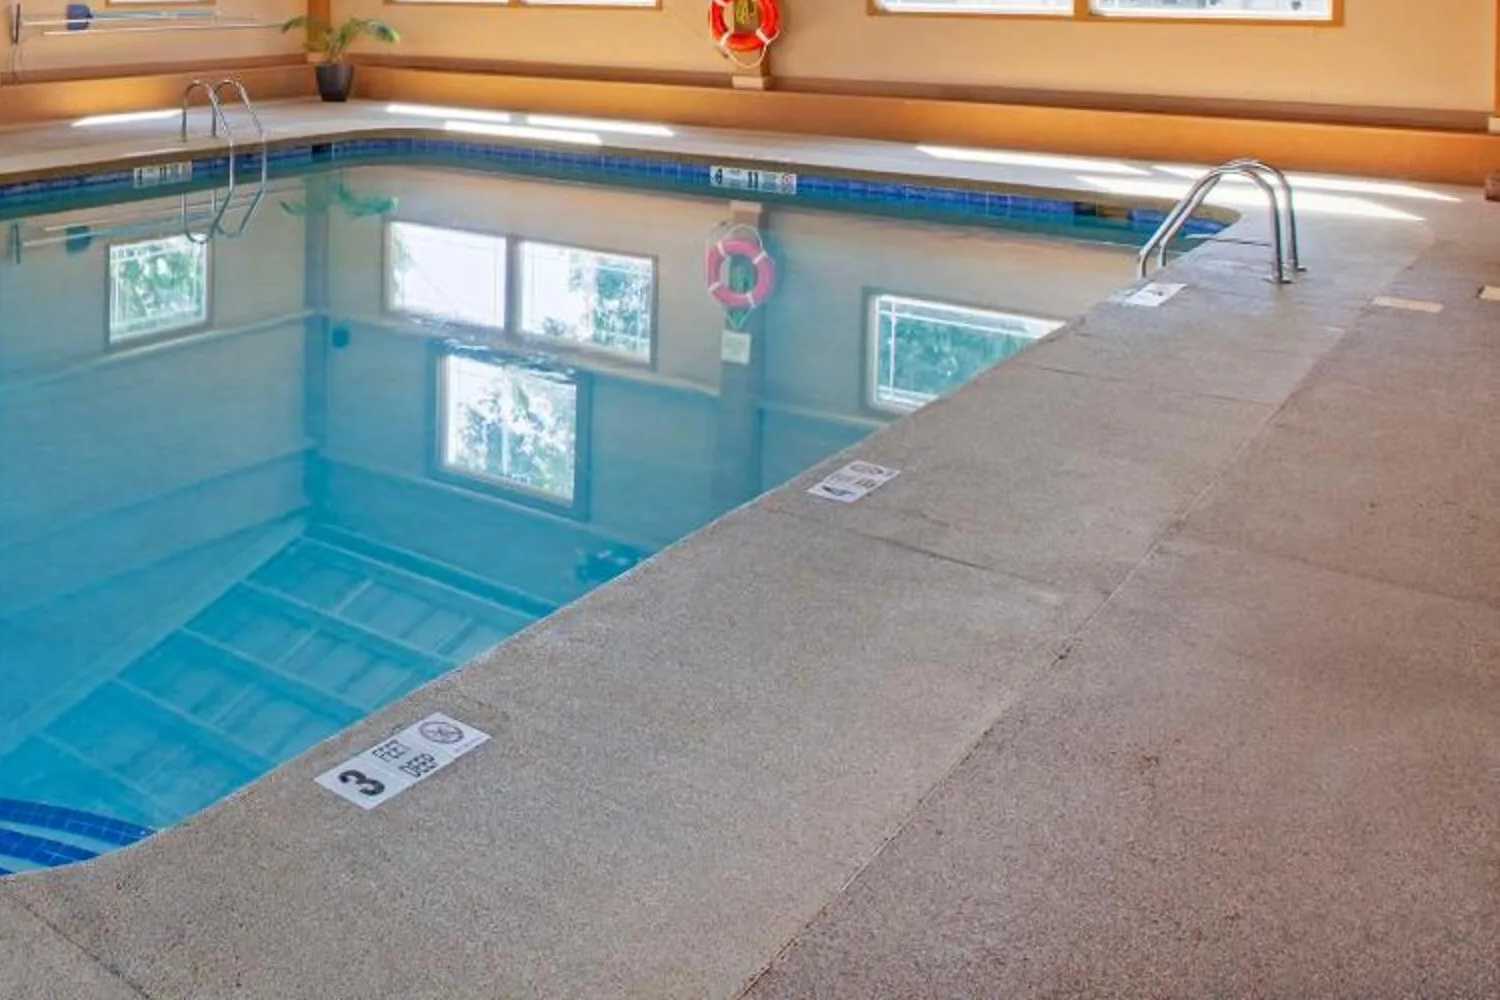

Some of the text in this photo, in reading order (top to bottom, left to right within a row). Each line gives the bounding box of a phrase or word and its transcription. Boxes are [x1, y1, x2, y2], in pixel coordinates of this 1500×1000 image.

[372, 739, 411, 763] FEET
[399, 754, 438, 777] DEEP
[338, 769, 385, 796] 3
